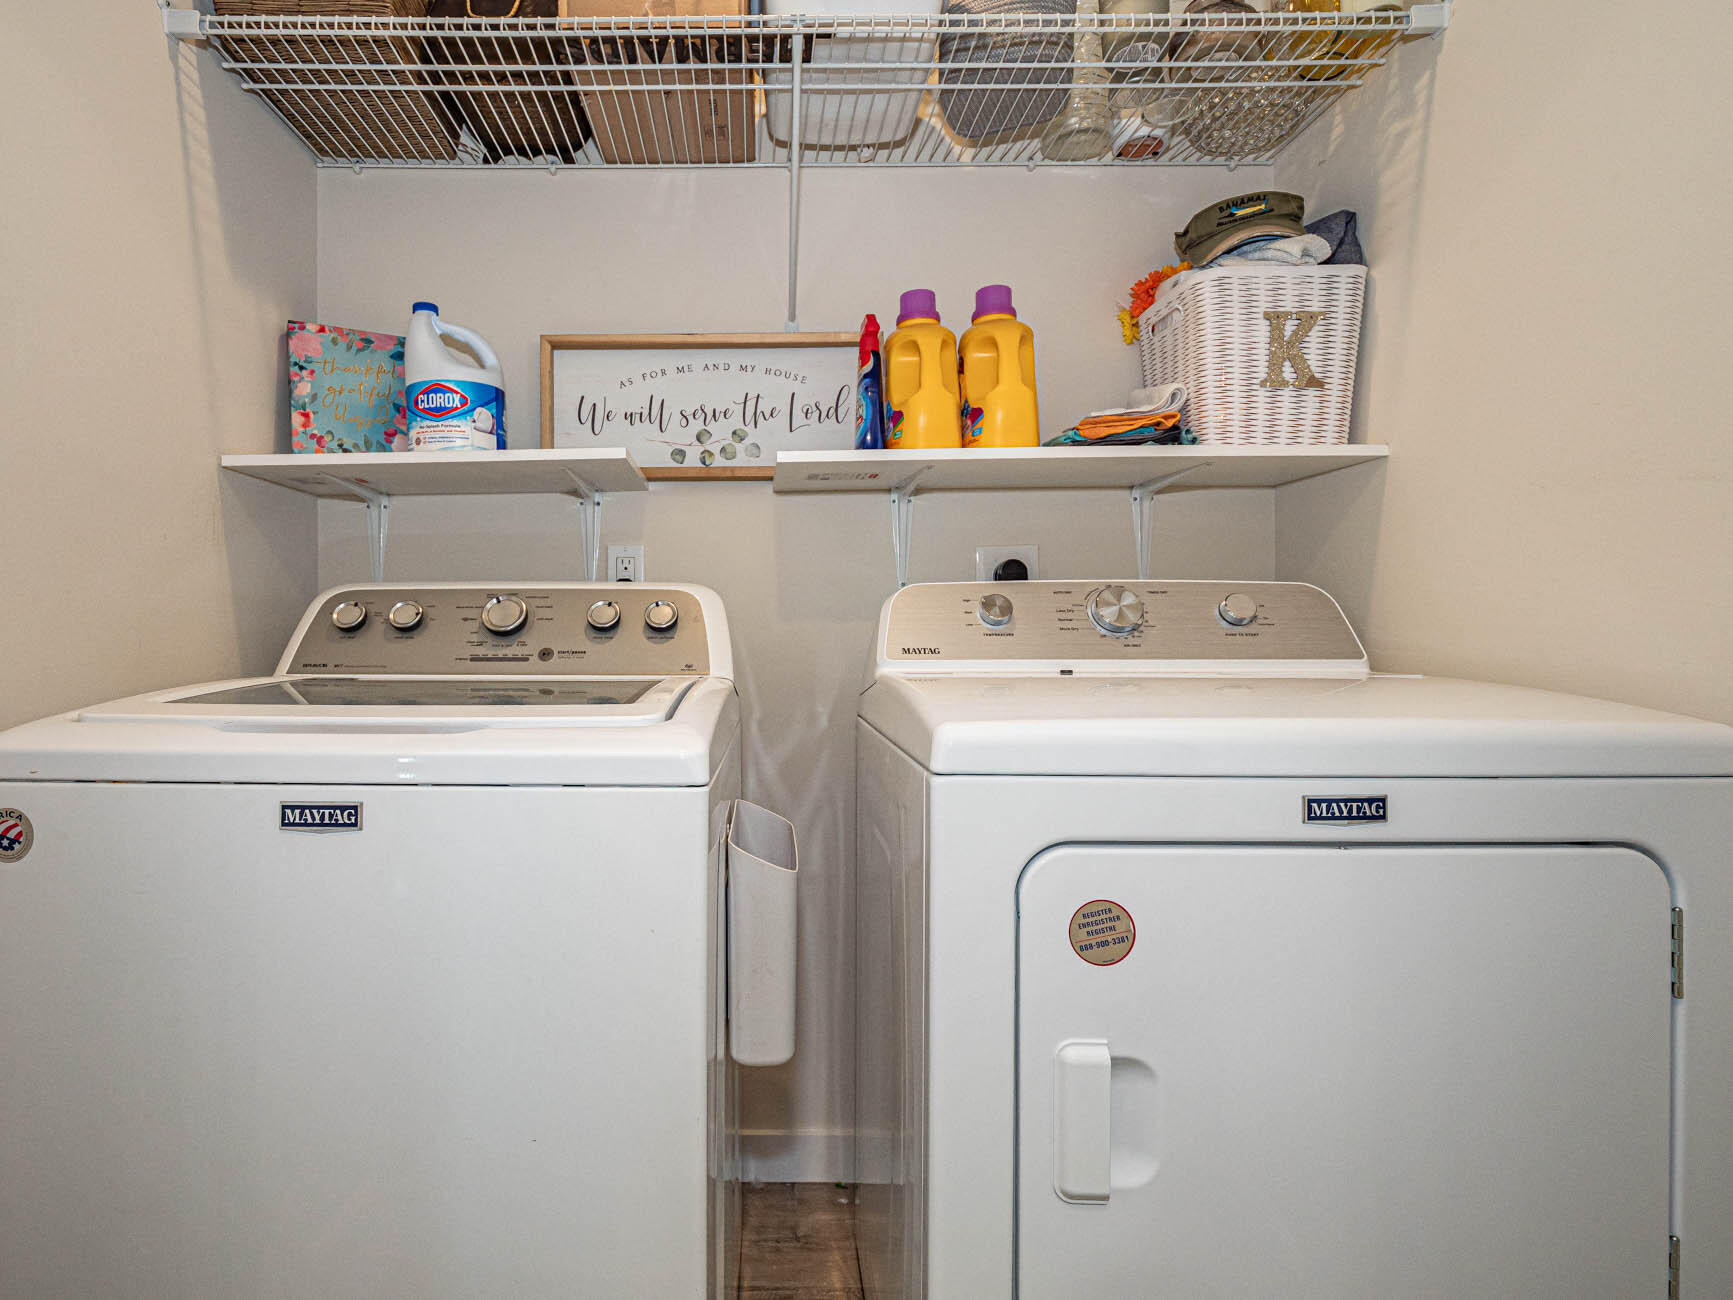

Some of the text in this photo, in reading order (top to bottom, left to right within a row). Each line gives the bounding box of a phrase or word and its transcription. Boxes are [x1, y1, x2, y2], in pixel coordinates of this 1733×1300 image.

[1260, 311, 1326, 388] K
[619, 362, 807, 389] AS FOR ME AND MY HOUSE
[418, 393, 461, 409] CLOROX
[577, 394, 617, 436] We
[624, 393, 672, 433] will
[679, 403, 734, 428] serve
[733, 392, 782, 429] the
[789, 384, 850, 433] Lord
[901, 647, 941, 655] MAYTAG
[283, 808, 356, 824] MAYTAG
[1310, 802, 1384, 817] MAYTAG
[1082, 907, 1113, 919] REGISTER
[1078, 915, 1121, 930] ENREGISTRER
[1086, 925, 1117, 937] REGISTRE
[1079, 935, 1130, 952] 888-900-3381
